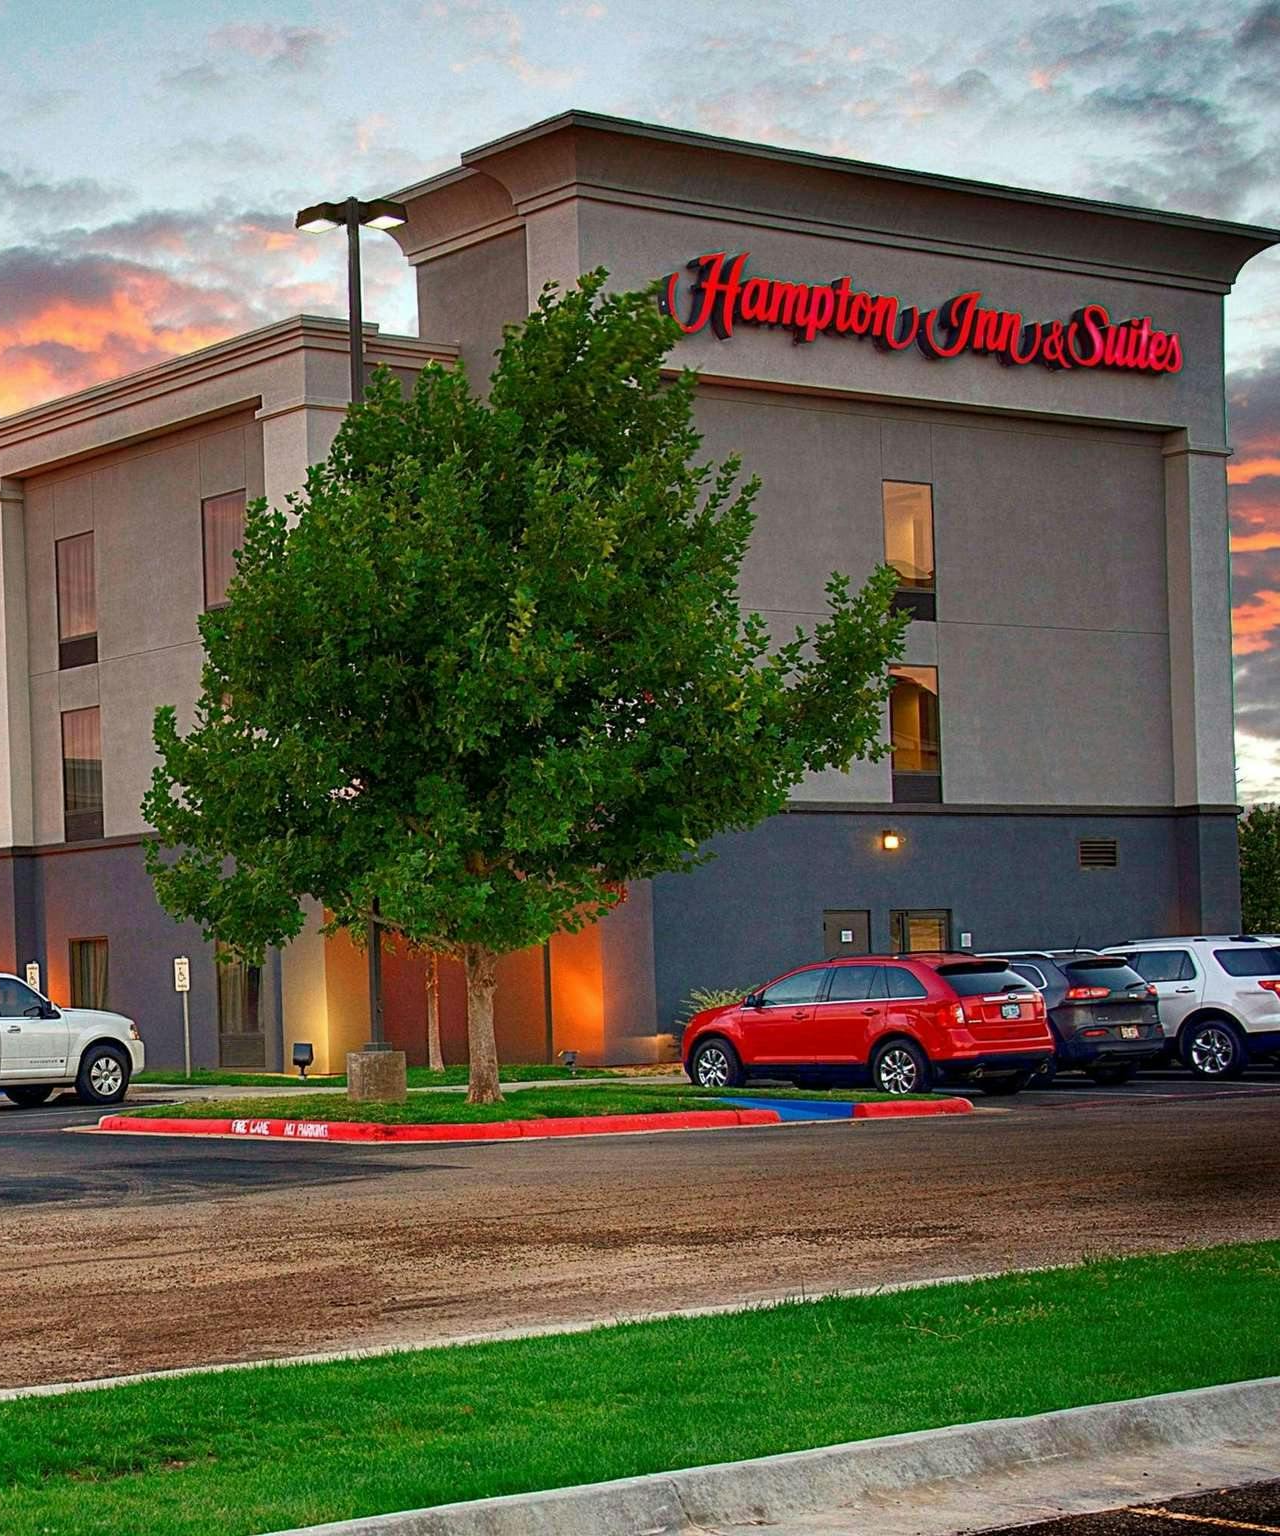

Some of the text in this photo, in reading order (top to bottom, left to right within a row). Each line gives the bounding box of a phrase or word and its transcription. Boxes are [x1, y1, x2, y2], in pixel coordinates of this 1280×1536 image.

[664, 251, 1183, 374] Hampton Inn & Suites
[231, 1119, 271, 1136] FIRE LANE
[283, 1122, 329, 1138] NO PARKING
